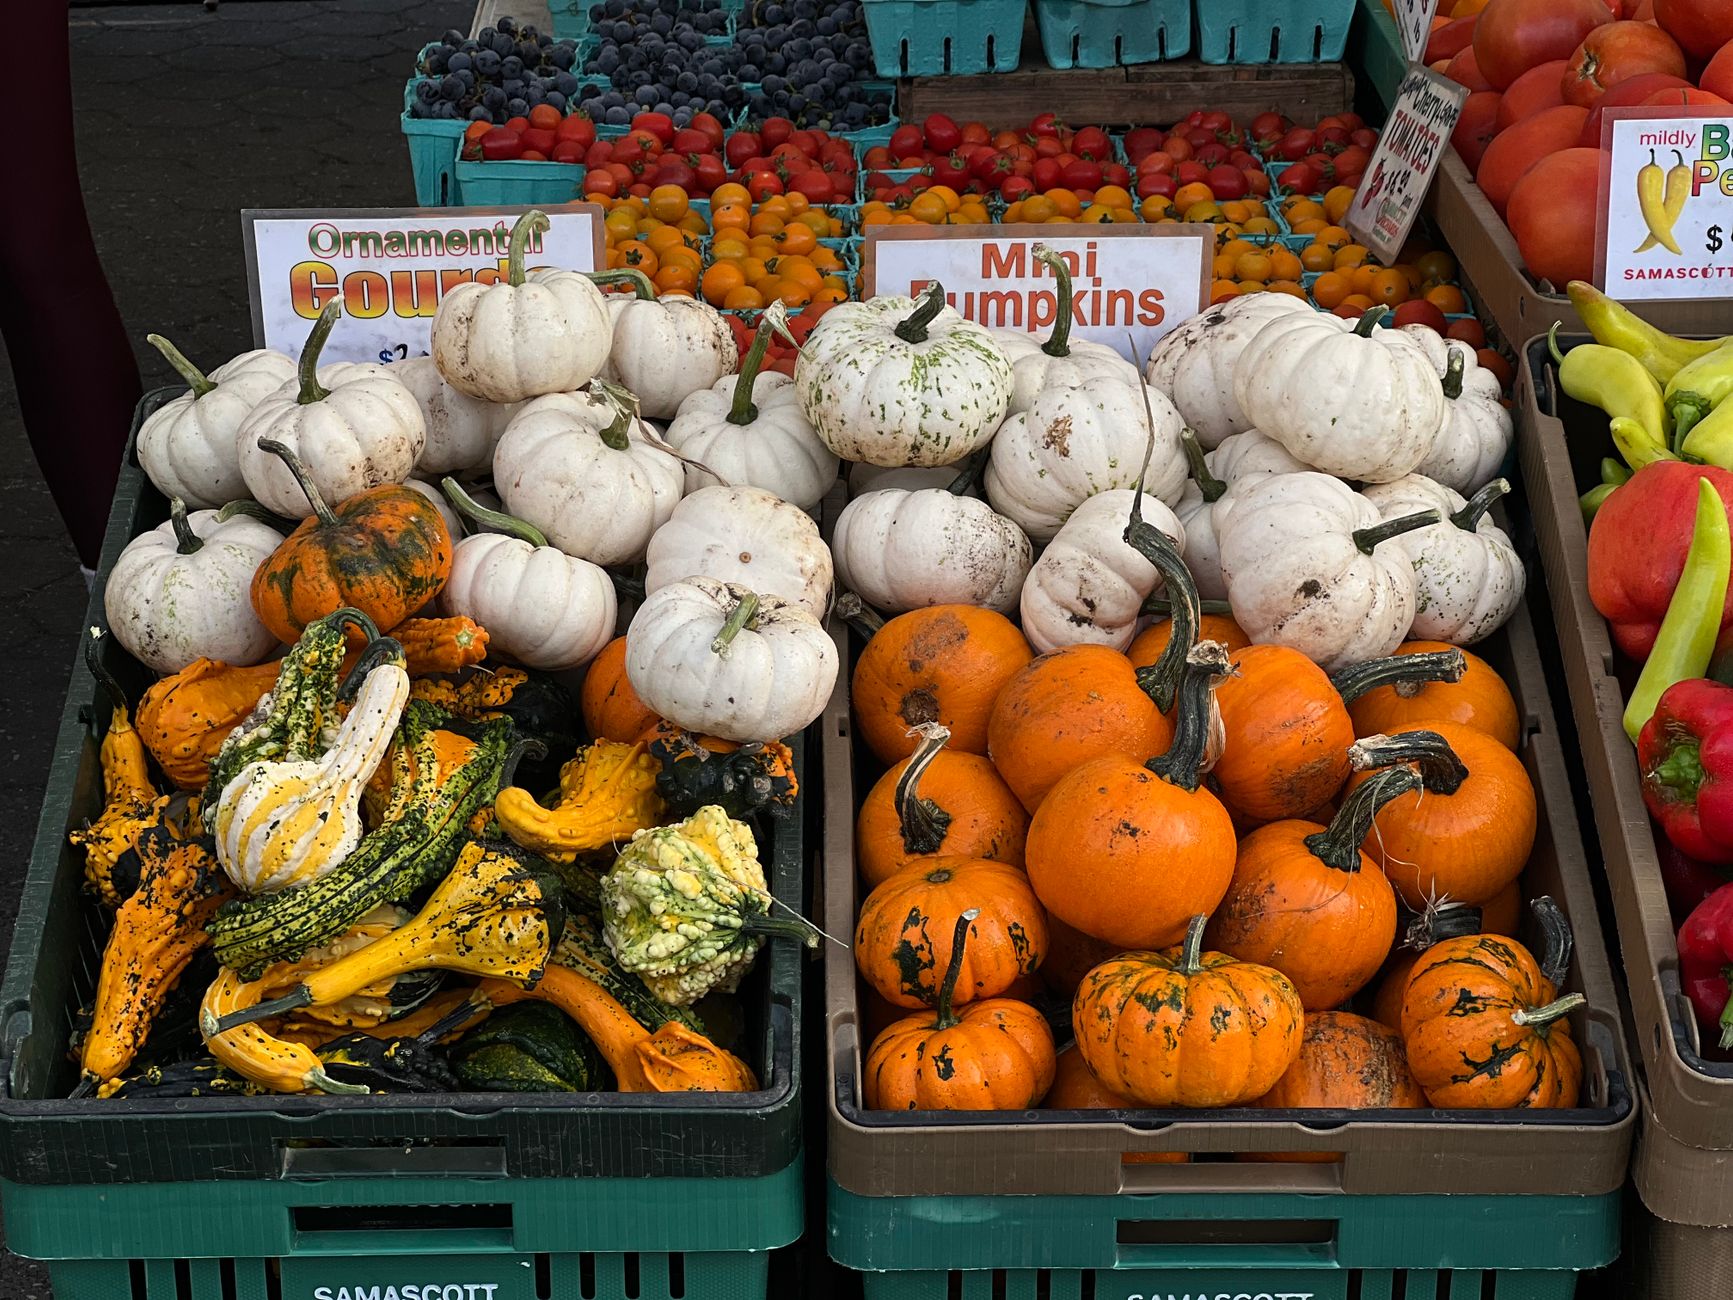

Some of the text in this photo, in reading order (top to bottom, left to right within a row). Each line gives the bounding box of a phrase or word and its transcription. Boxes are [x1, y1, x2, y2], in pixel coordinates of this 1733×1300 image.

[1384, 109, 1440, 175] TOMATOES
[1639, 130, 1697, 148] mildly
[1701, 124, 1733, 161] B
